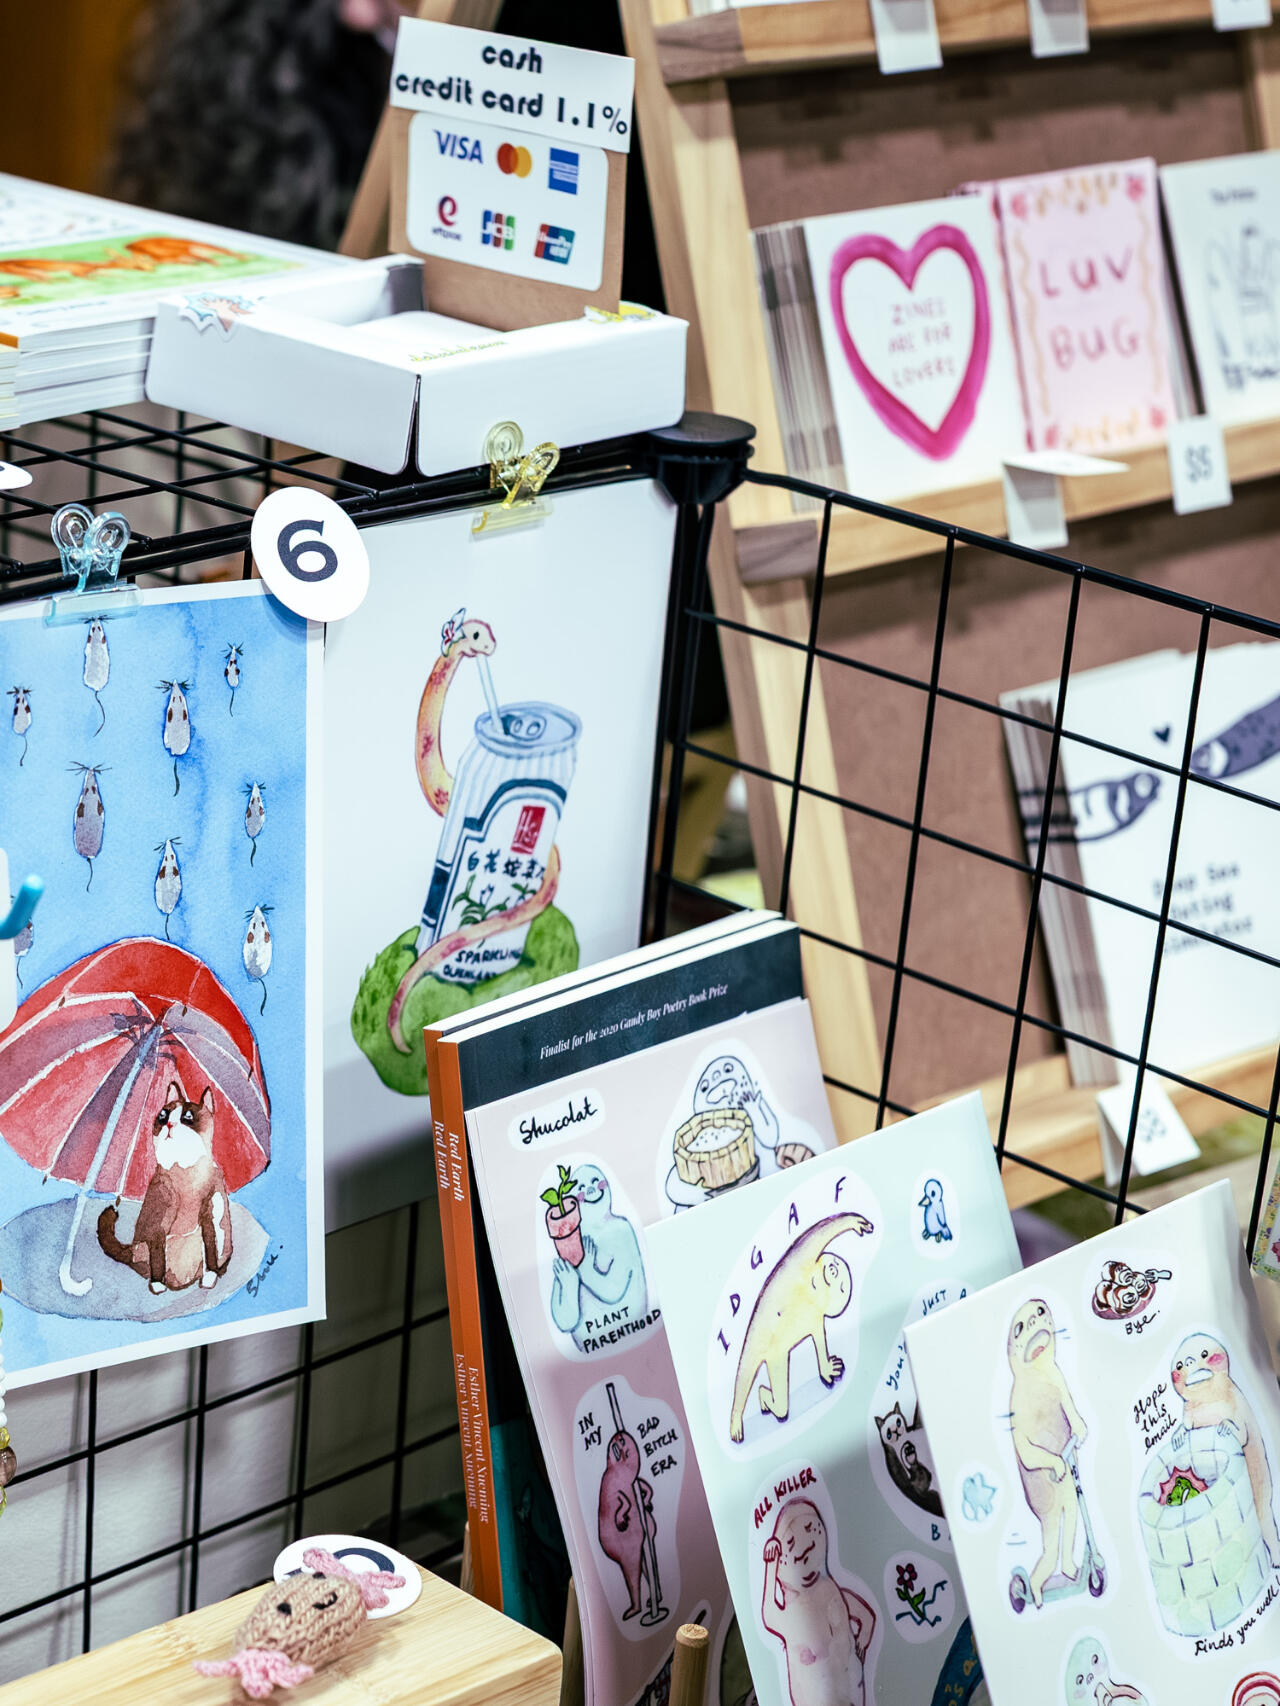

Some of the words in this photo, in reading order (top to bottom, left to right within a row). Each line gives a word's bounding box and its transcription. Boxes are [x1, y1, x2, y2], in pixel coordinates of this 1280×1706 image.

[481, 46, 543, 73] cash
[396, 74, 472, 105] credit
[481, 90, 543, 118] card
[433, 129, 483, 165] VISA
[1038, 244, 1133, 297] LUV
[1050, 317, 1139, 371] BUG
[277, 519, 338, 582] 6
[540, 1038, 570, 1060] Finalist
[571, 1034, 584, 1051] for
[585, 1028, 599, 1043] the
[599, 1024, 619, 1038] 2020
[646, 1007, 661, 1023] Boy
[663, 999, 687, 1015] Poetry
[688, 989, 707, 1007] Book
[708, 984, 729, 1000] Prize
[434, 1120, 447, 1148] Red
[519, 1096, 598, 1145] Shucolat
[448, 1132, 461, 1161] Red
[437, 1149, 450, 1189] Earth
[451, 1162, 465, 1202] Earth
[583, 1308, 661, 1354] PARENTHOOD
[585, 1306, 630, 1333] PLANT
[455, 1353, 467, 1399] Esther
[468, 1366, 481, 1413] Esther
[578, 1412, 594, 1434] IN
[1133, 1383, 1167, 1423] Hope
[1141, 1403, 1167, 1432] this
[473, 1413, 485, 1462] Vincent
[584, 1426, 602, 1451] MY
[637, 1416, 660, 1439] BAD
[643, 1428, 678, 1457] BITCH
[1144, 1414, 1177, 1455] email
[650, 1455, 678, 1477] ERA
[476, 1462, 491, 1524] Xueming
[754, 1496, 772, 1529] ALL
[774, 1467, 817, 1503] KILLER
[1237, 1617, 1256, 1644] you
